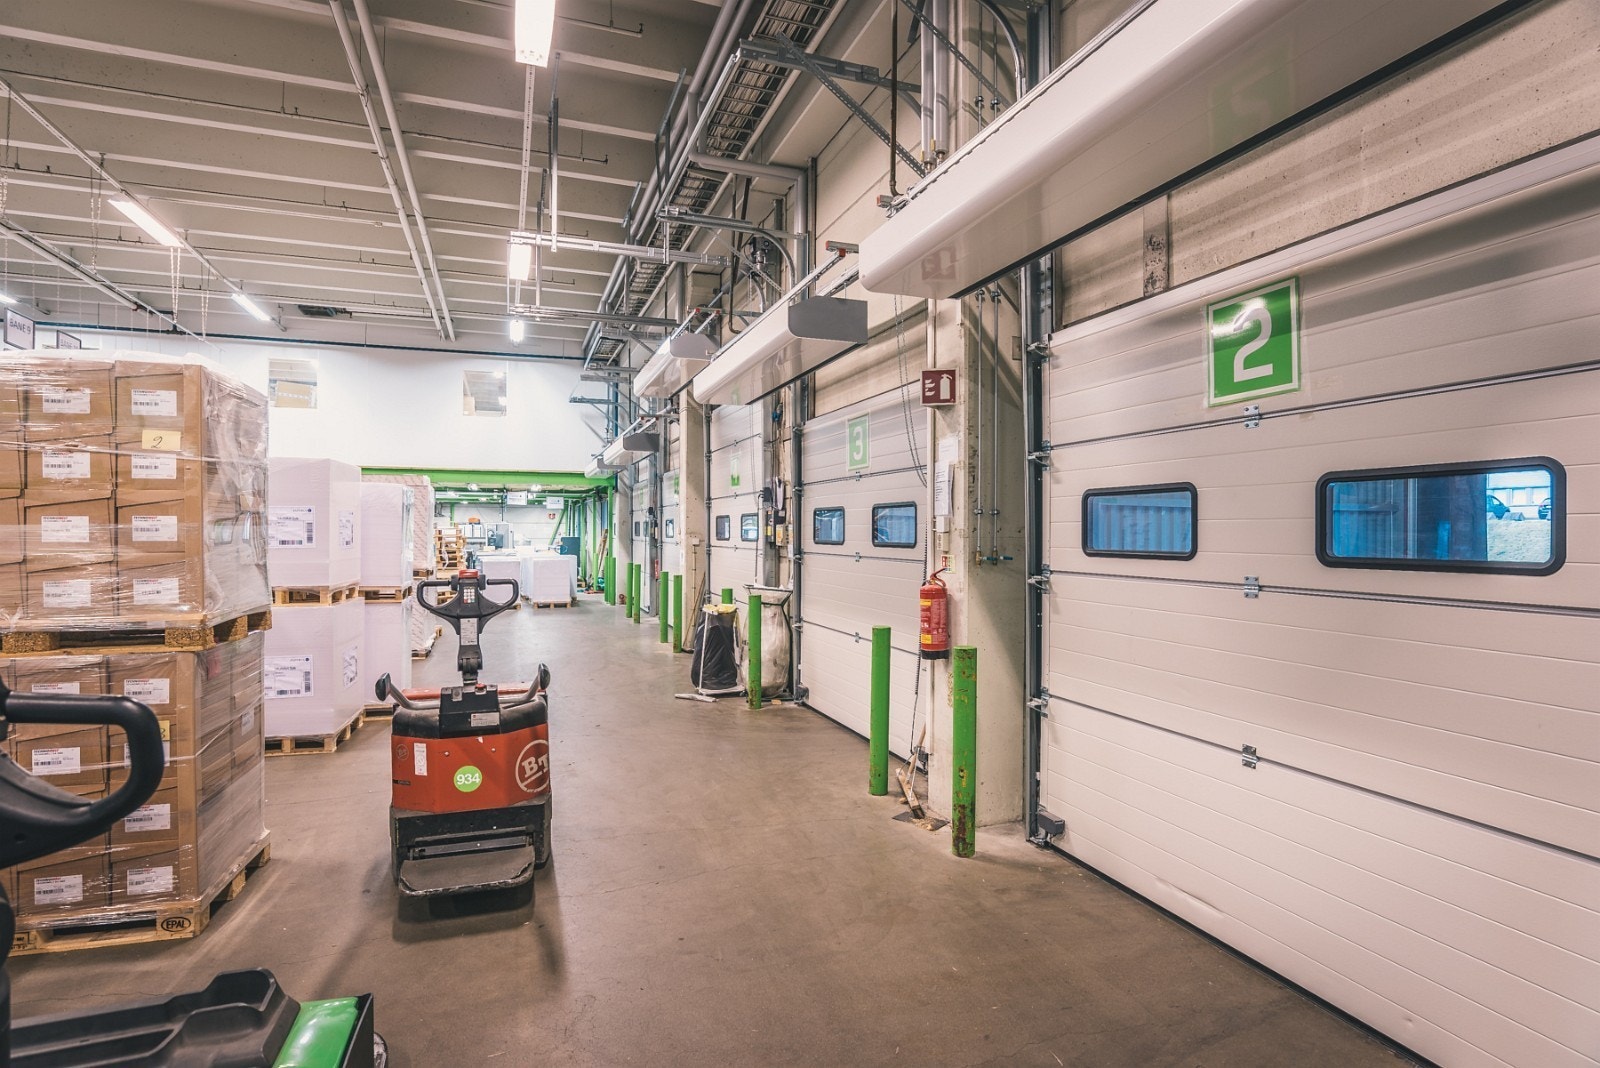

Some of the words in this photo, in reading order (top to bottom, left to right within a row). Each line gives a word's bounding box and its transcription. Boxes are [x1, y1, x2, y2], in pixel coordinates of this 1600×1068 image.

[1233, 307, 1273, 383] 2
[151, 436, 163, 449] 2
[853, 426, 863, 461] 3
[456, 772, 480, 785] 934
[166, 919, 185, 930] EPAL
